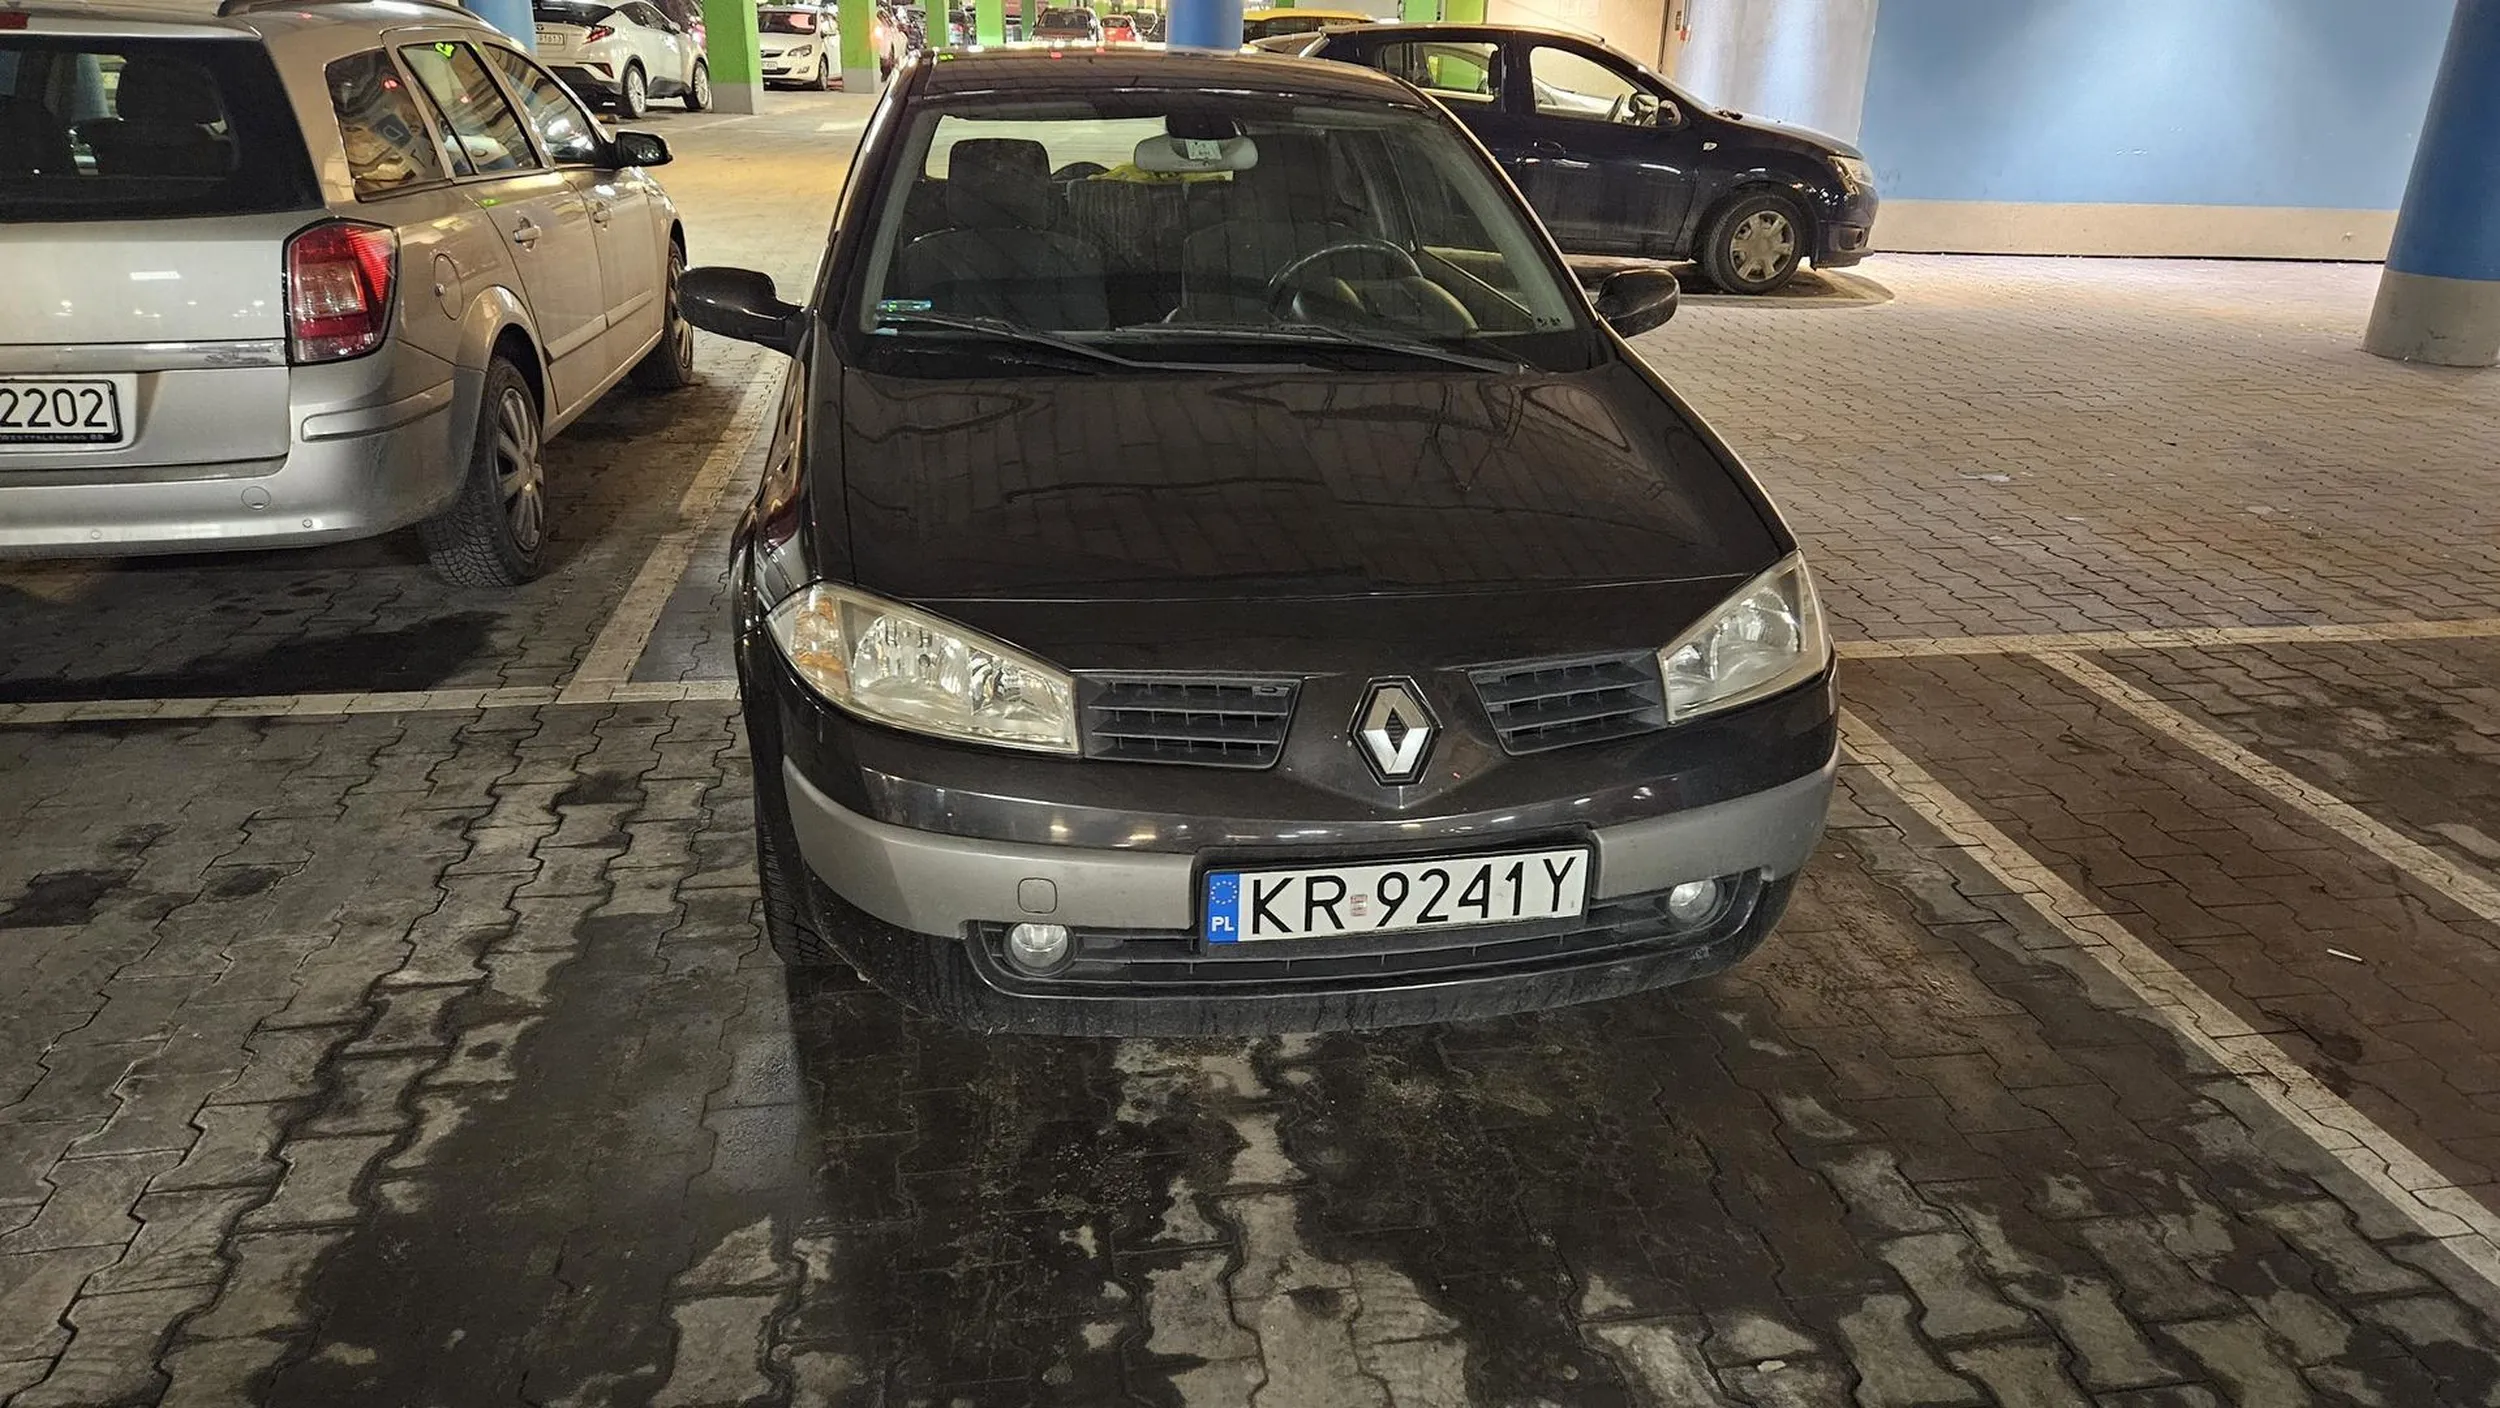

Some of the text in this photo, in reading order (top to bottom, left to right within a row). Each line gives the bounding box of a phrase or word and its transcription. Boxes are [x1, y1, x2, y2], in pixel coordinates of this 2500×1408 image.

[0, 388, 107, 427] 2202
[1252, 856, 1577, 935] KR 9241Y
[1211, 916, 1235, 932] PL
